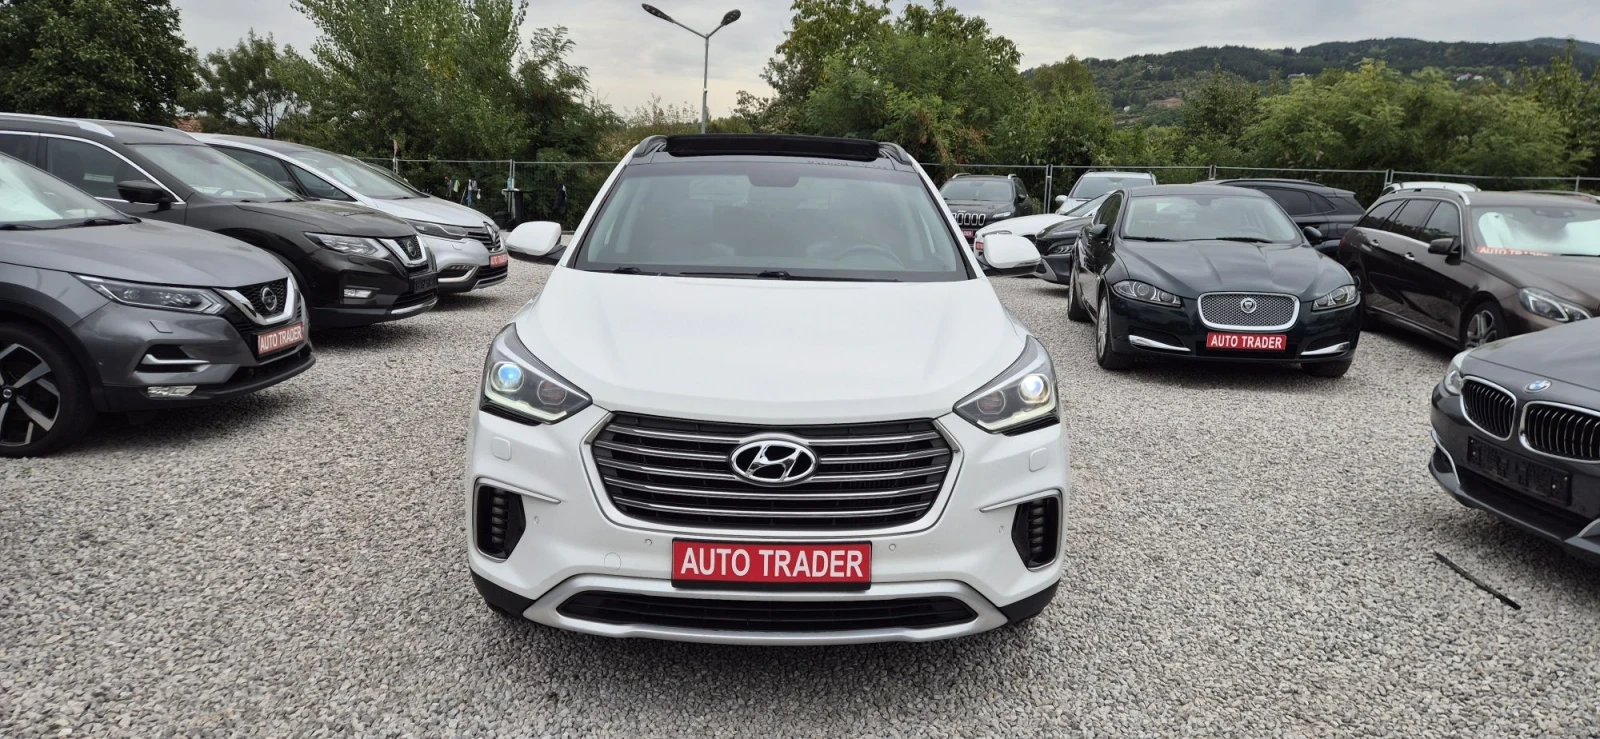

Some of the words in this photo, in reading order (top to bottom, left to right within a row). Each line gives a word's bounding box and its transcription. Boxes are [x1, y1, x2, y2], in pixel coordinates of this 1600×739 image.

[260, 333, 278, 350] AUTO
[279, 325, 302, 345] TRADER
[1211, 334, 1238, 348] AUTO
[1241, 336, 1283, 349] TRADER
[680, 547, 750, 577] AUTO
[758, 549, 864, 578] TRADER
